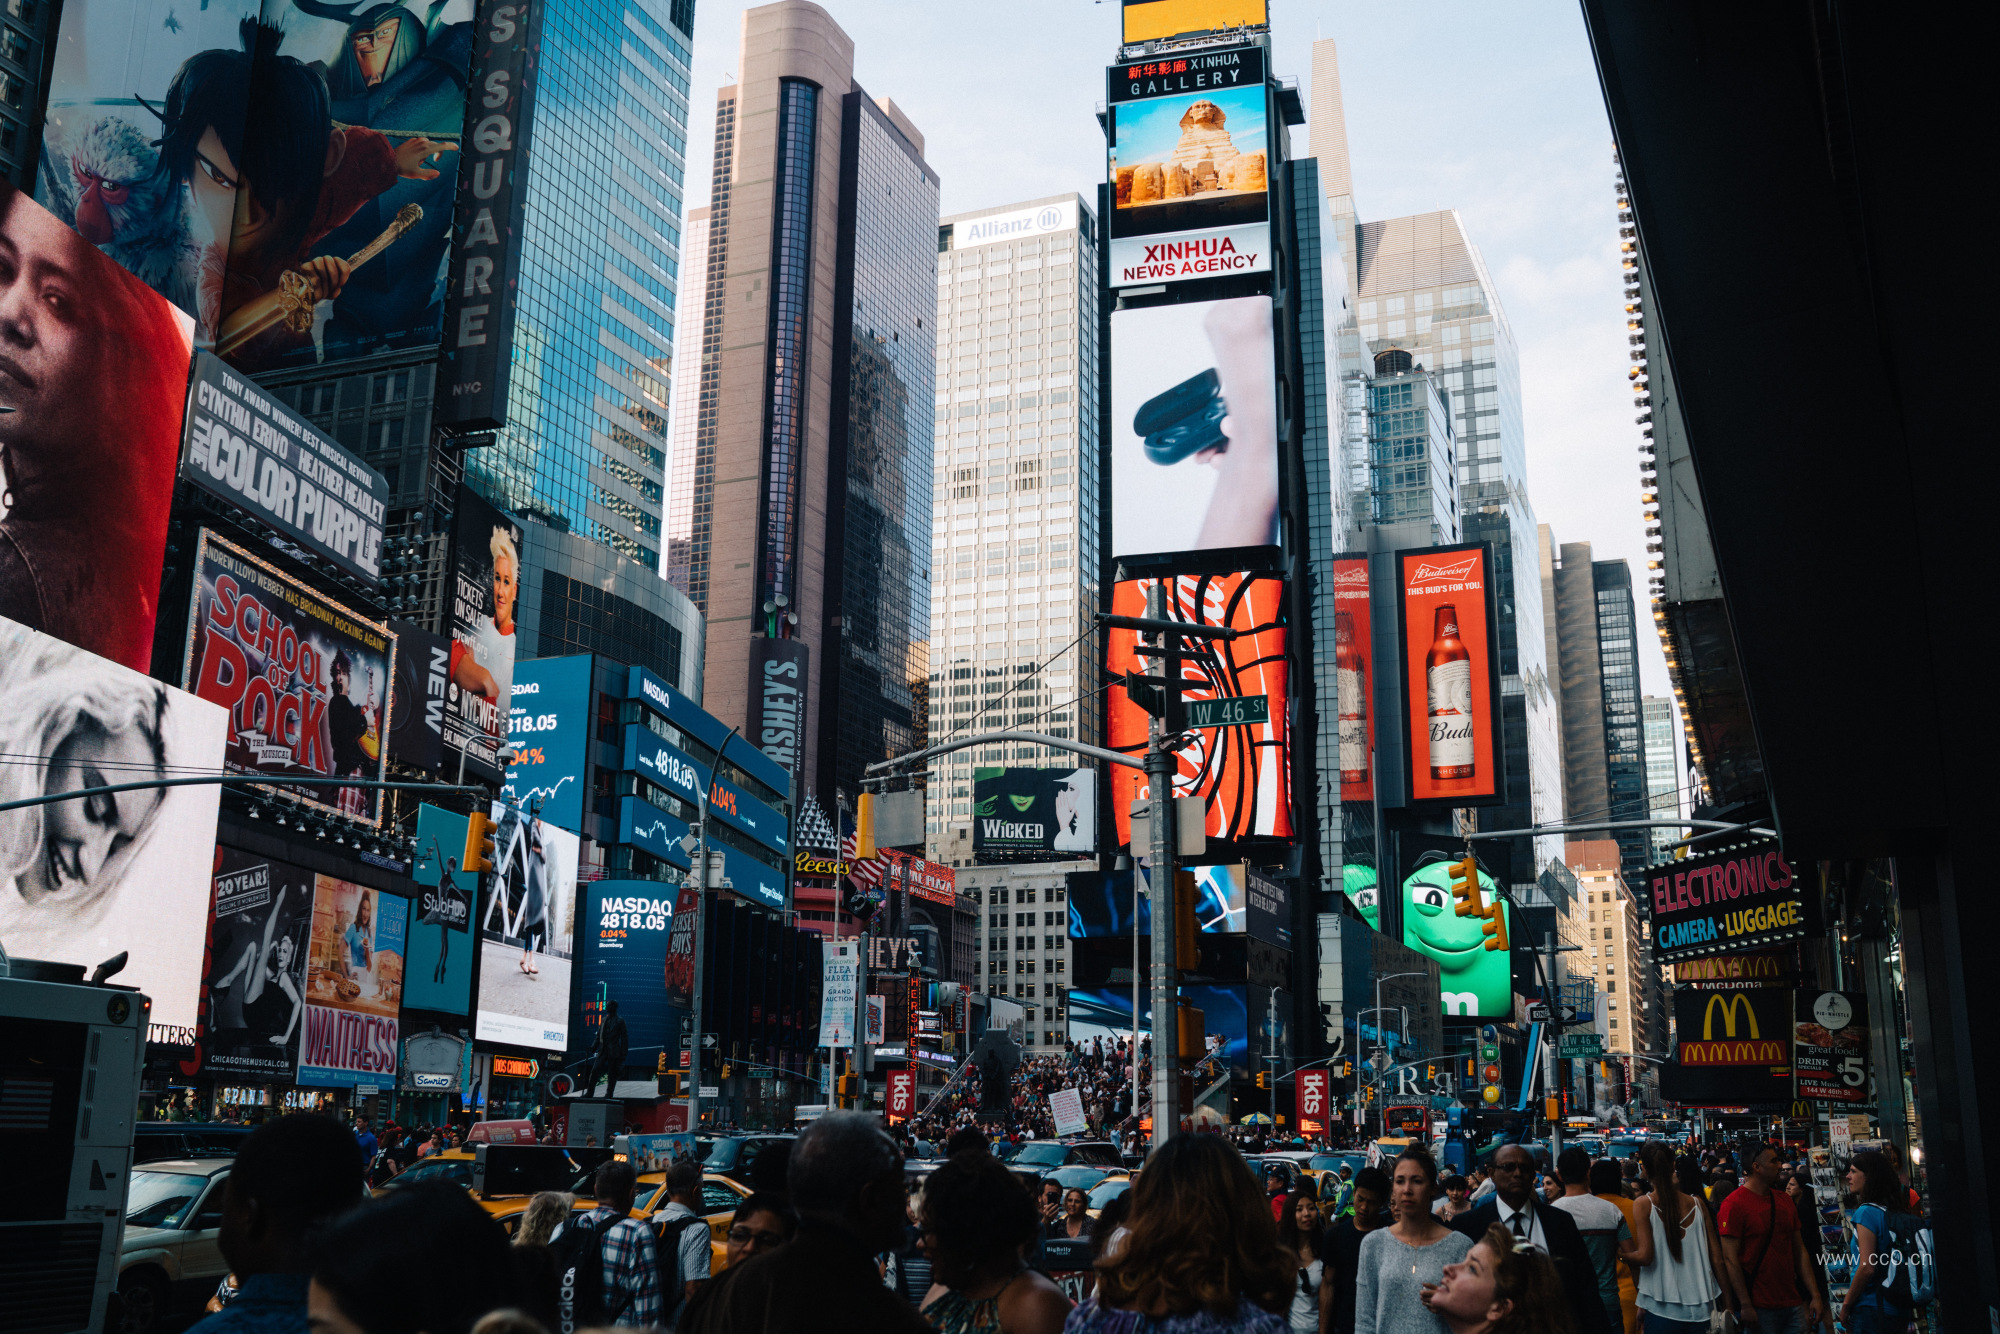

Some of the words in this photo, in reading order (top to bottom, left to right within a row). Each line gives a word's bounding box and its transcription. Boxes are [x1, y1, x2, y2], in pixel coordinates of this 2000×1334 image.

[1128, 60, 1187, 79] 新华影廊
[1190, 53, 1241, 70] XINHUA
[1131, 69, 1240, 95] GALLERY
[457, 70, 512, 348] SQUARE
[967, 217, 1033, 241] Allianz
[1143, 237, 1236, 263] XINHUA
[1123, 263, 1176, 281] NEWS
[1180, 253, 1258, 275] AGENCY
[452, 381, 482, 396] NYC
[222, 372, 245, 397] TONY
[243, 387, 271, 416] AWARD
[272, 406, 303, 438] WINNER!
[302, 428, 321, 451] BEST
[319, 441, 348, 472] MUSICAL
[347, 460, 373, 489] REVIVAL
[198, 380, 250, 436] CYNTHIA
[252, 416, 289, 460] ERIVO
[298, 448, 344, 499] HEATHER
[343, 479, 385, 525] HEADLEY
[189, 415, 214, 472] THE
[207, 424, 298, 525] COLOR
[295, 479, 383, 577] PURPLE
[1415, 565, 1470, 579] Budweiser
[204, 545, 235, 572] ANDREW
[234, 558, 257, 583] LLOYD
[257, 573, 285, 600] WEBBER
[284, 589, 300, 608] HAS
[299, 598, 335, 627] BROADWAY
[334, 617, 363, 642] ROCKING
[364, 632, 387, 653] AGAIN!
[457, 577, 484, 609] TICKETS
[1406, 587, 1424, 596] THIS
[1424, 585, 1447, 594] BUD'S
[1448, 584, 1464, 593] FOR
[1464, 581, 1483, 591] YOU.
[454, 598, 465, 619] ON
[464, 604, 484, 630] SALE!
[209, 574, 327, 693] SCHOOL
[452, 627, 488, 659] nycwff.org
[268, 662, 289, 692] OF
[195, 625, 327, 774] ROCK
[425, 647, 448, 735] NEW
[643, 678, 670, 709] NASDAQ
[460, 689, 500, 733] NYCWFF
[1196, 704, 1212, 724] W
[1222, 701, 1245, 722] 46
[1253, 698, 1265, 713] St
[252, 739, 265, 747] THE
[260, 749, 290, 760] MUSICAL
[654, 749, 693, 790] 4818.05
[362, 852, 389, 867] OUTFRONT
[389, 861, 404, 872] PRIME
[795, 851, 850, 875] Reese's
[217, 879, 234, 897] 20
[233, 870, 267, 892] YEARS
[910, 886, 928, 897] HOTEL
[925, 875, 952, 893] PLAZA
[1262, 880, 1276, 899] HOTTEST
[1275, 886, 1285, 903] THING
[1653, 851, 1793, 914] ELECTRONICS
[423, 892, 467, 918] StubHub
[601, 897, 672, 917] NASDAQ
[1249, 891, 1254, 905] IN
[1253, 892, 1262, 908] TECH
[1261, 895, 1267, 911] BE
[600, 913, 666, 931] 4818.05
[600, 929, 628, 938] -0.04%
[670, 910, 697, 933] JERSEY
[1658, 917, 1718, 949] CAMERA
[1724, 900, 1798, 937] LUGGAGE
[670, 932, 692, 954] BOYS
[828, 965, 851, 974] FLEA
[867, 1002, 881, 1036] PayDay
[909, 977, 919, 1071] HERSHEY'S
[1401, 1006, 1412, 1045] R
[1535, 1010, 1548, 1018] ONE
[306, 1005, 397, 1073] WAITRESS
[1569, 1036, 1577, 1045] W
[1580, 1036, 1591, 1045] 46
[1582, 1046, 1599, 1054] Equity
[1808, 1046, 1832, 1055] great
[1834, 1046, 1858, 1056] food!
[211, 1054, 290, 1069] CHICAGOTHEMUSICAL.COM
[494, 1057, 508, 1075] DOS
[508, 1059, 531, 1076] CAMINOS
[1798, 1057, 1829, 1067] DRINK
[1837, 1057, 1865, 1087] $5
[416, 1075, 449, 1086] Sanrio
[553, 1080, 569, 1093] W
[893, 1074, 911, 1112] tkts
[1396, 1066, 1428, 1095] R
[224, 1088, 265, 1106] GRAND
[285, 1091, 317, 1108] SLAM
[1303, 1073, 1323, 1115] tkts
[1751, 1103, 1788, 1111] MONEY
